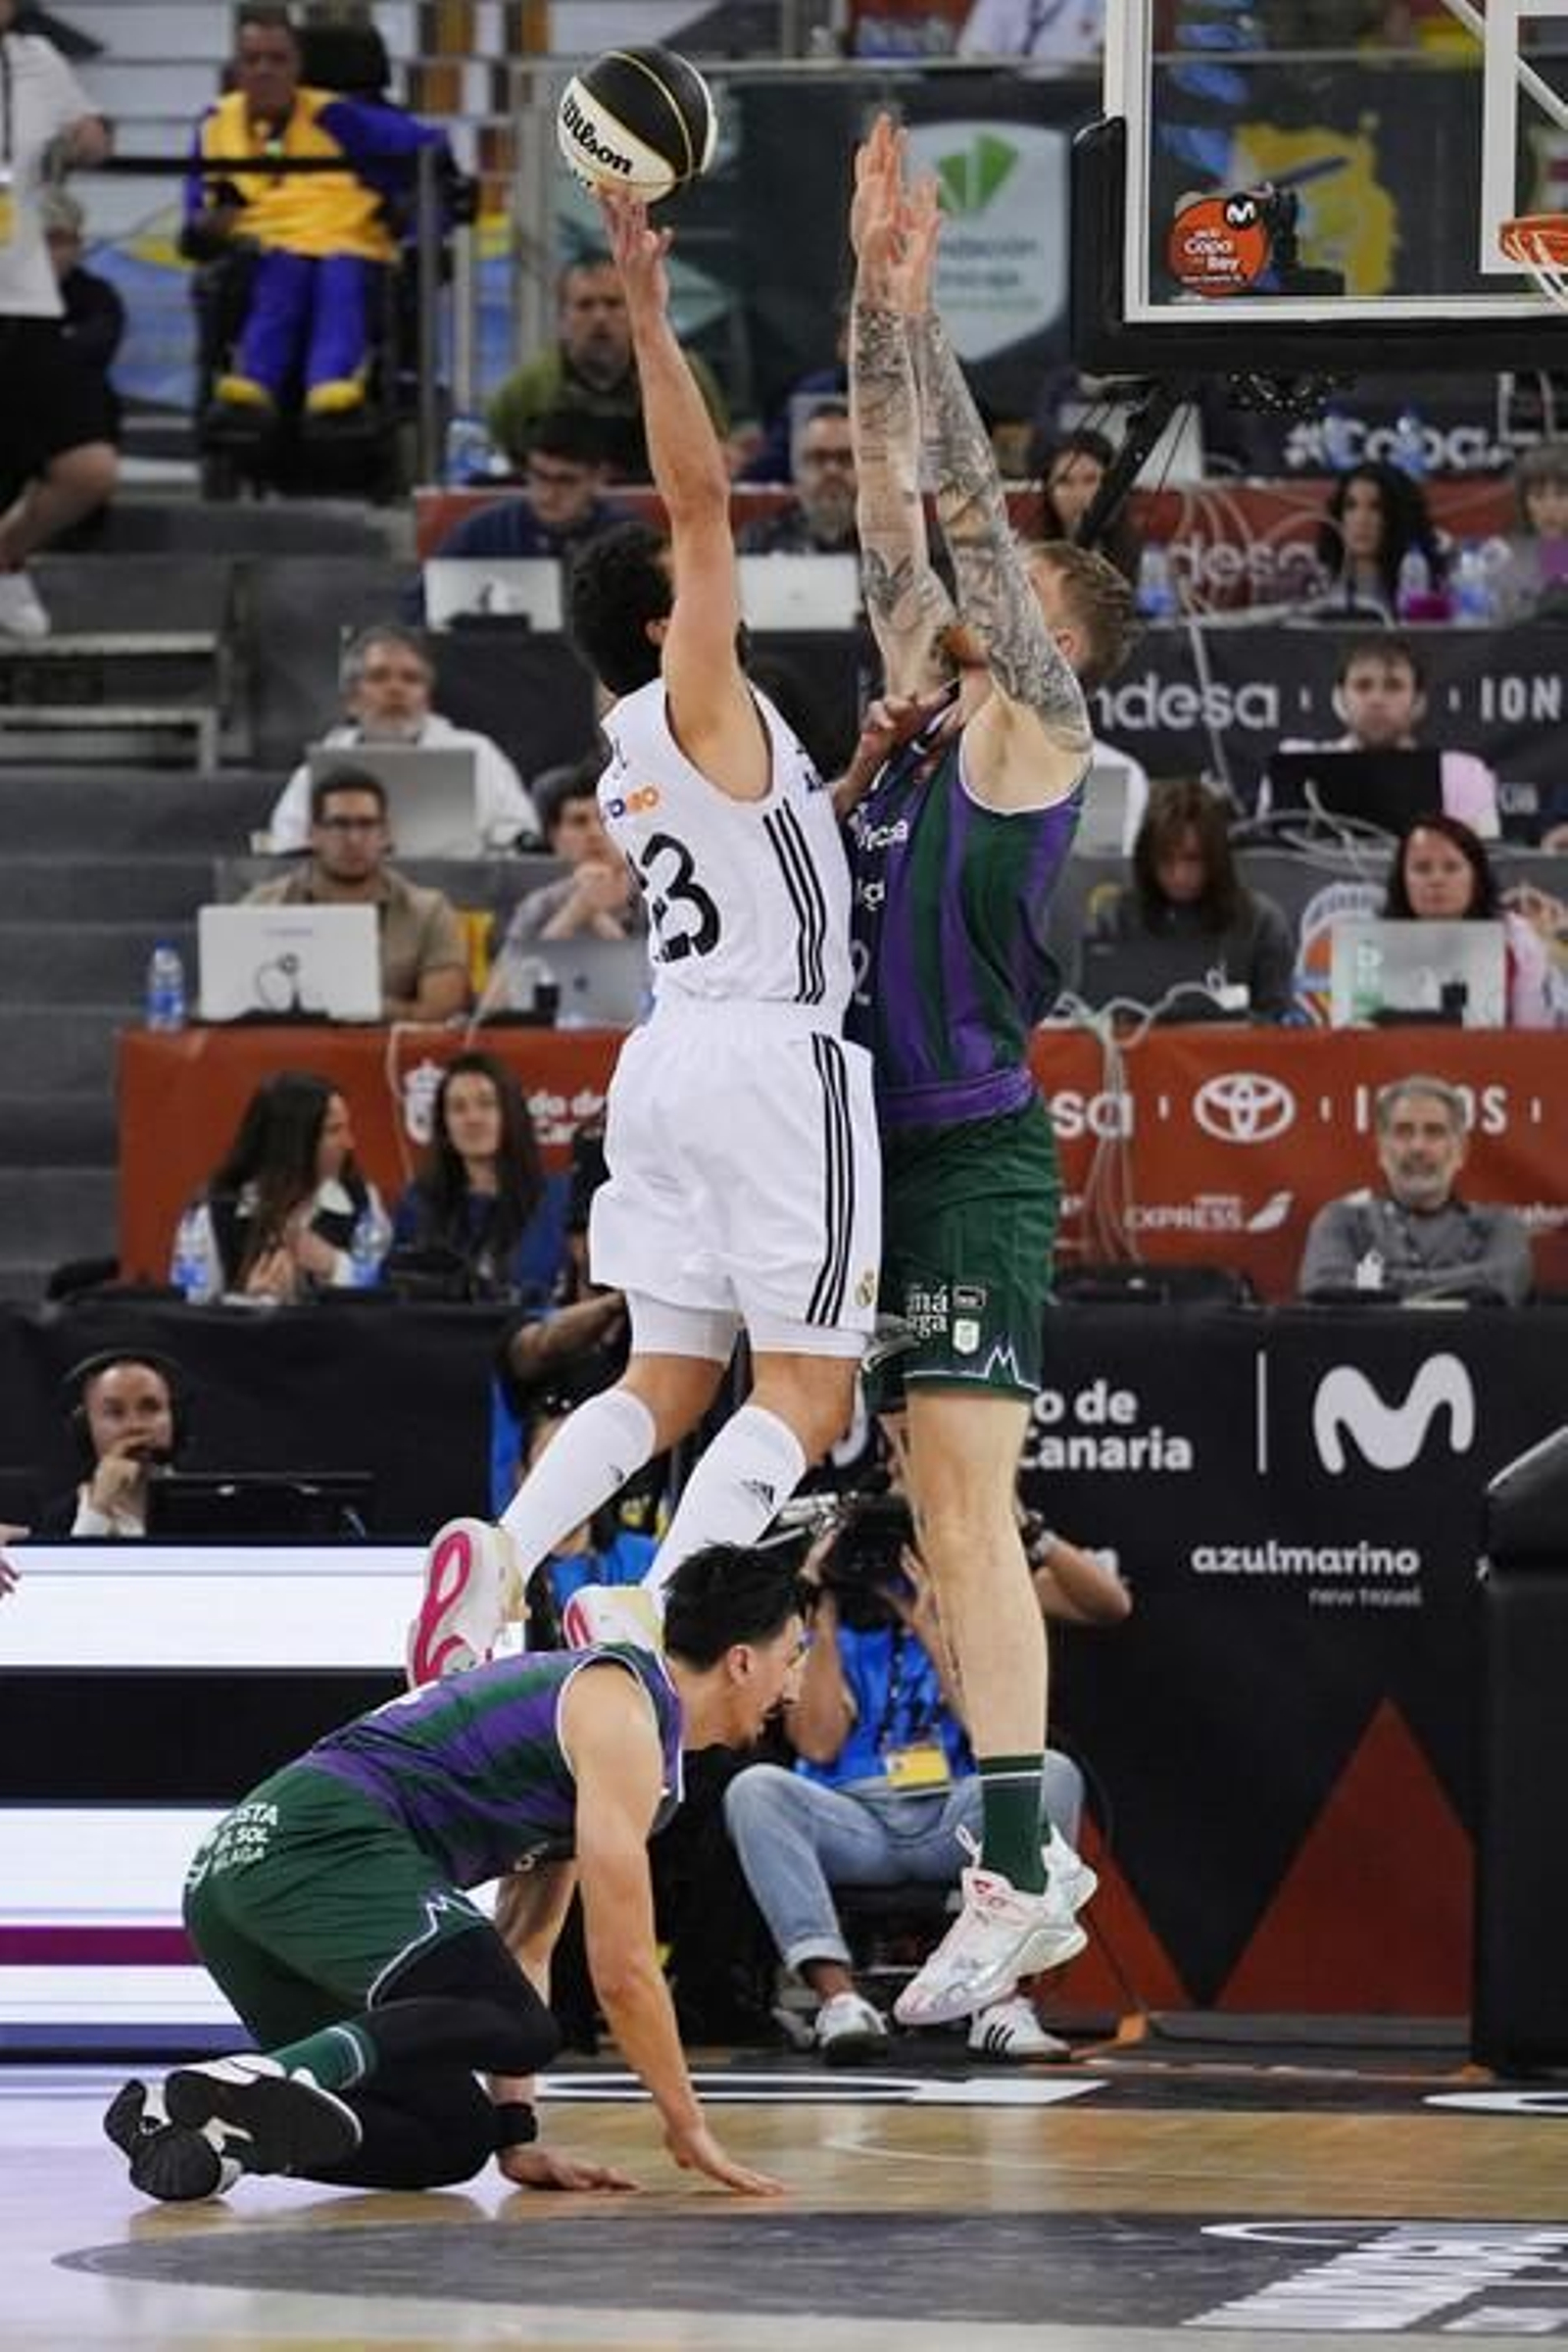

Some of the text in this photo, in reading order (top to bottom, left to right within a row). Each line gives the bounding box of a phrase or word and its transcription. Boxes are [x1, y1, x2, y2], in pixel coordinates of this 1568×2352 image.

[1168, 532, 1320, 582] desa
[1093, 670, 1278, 729] ndesa
[1075, 1379, 1138, 1424] de
[1191, 1541, 1421, 1576] azulmarino
[1309, 1589, 1354, 1607] new
